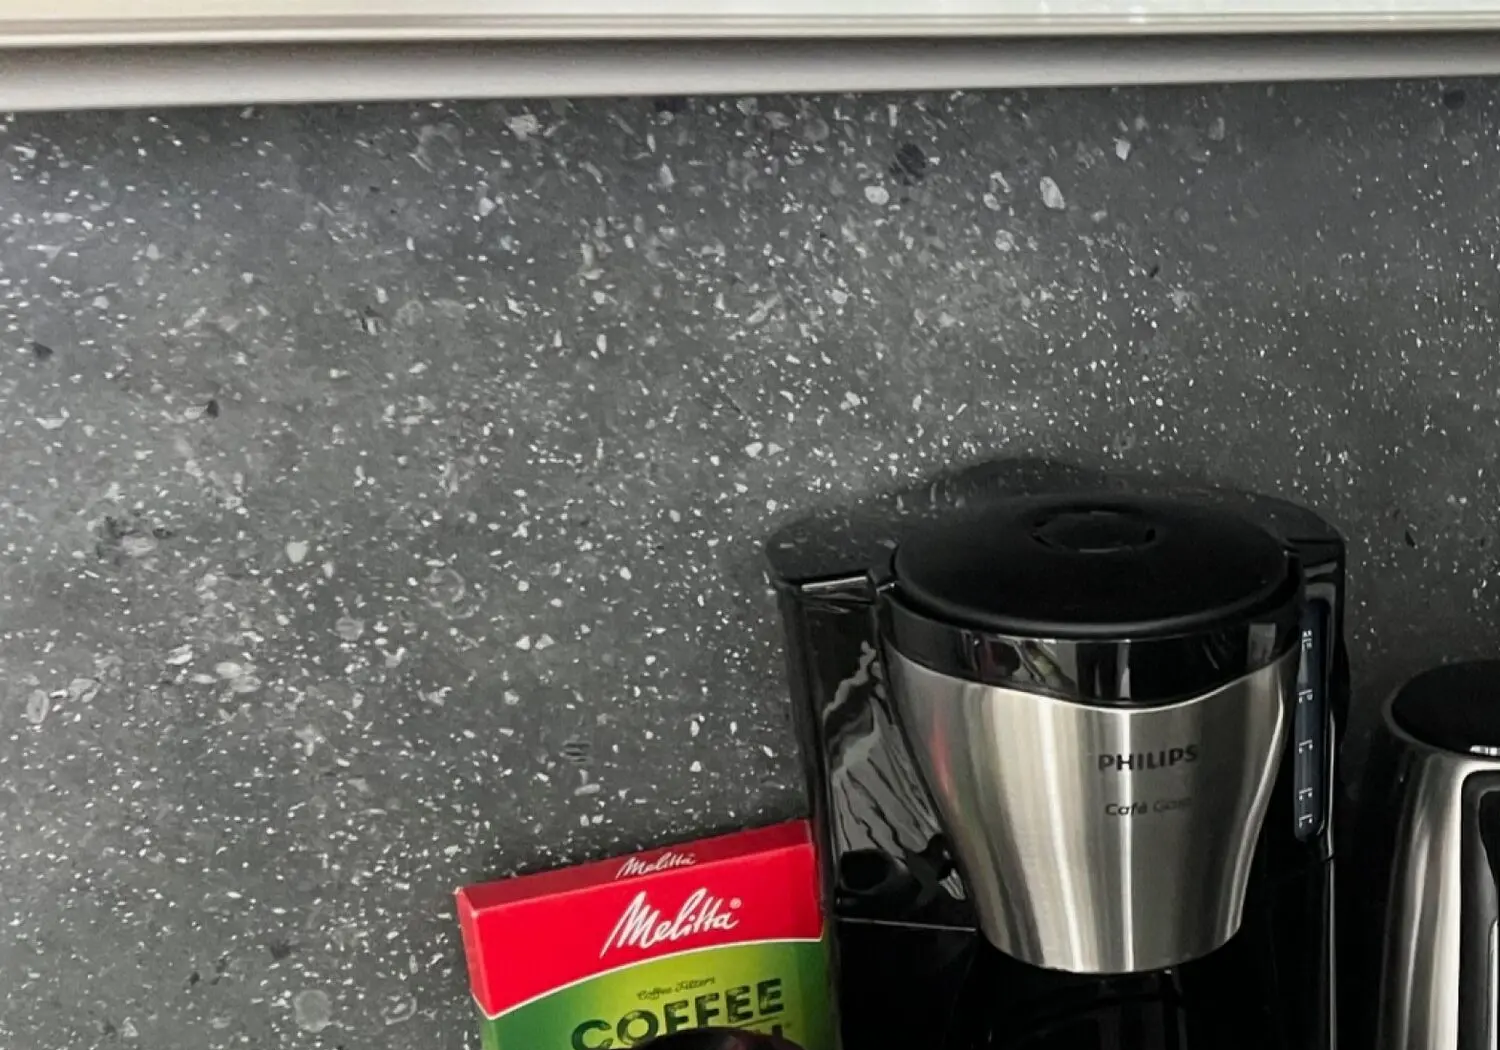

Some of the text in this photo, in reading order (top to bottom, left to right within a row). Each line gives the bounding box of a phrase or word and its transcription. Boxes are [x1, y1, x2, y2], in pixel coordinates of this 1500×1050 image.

[1098, 745, 1197, 771] PHILIPS
[615, 852, 696, 879] Melitta
[600, 887, 741, 959] Melitta
